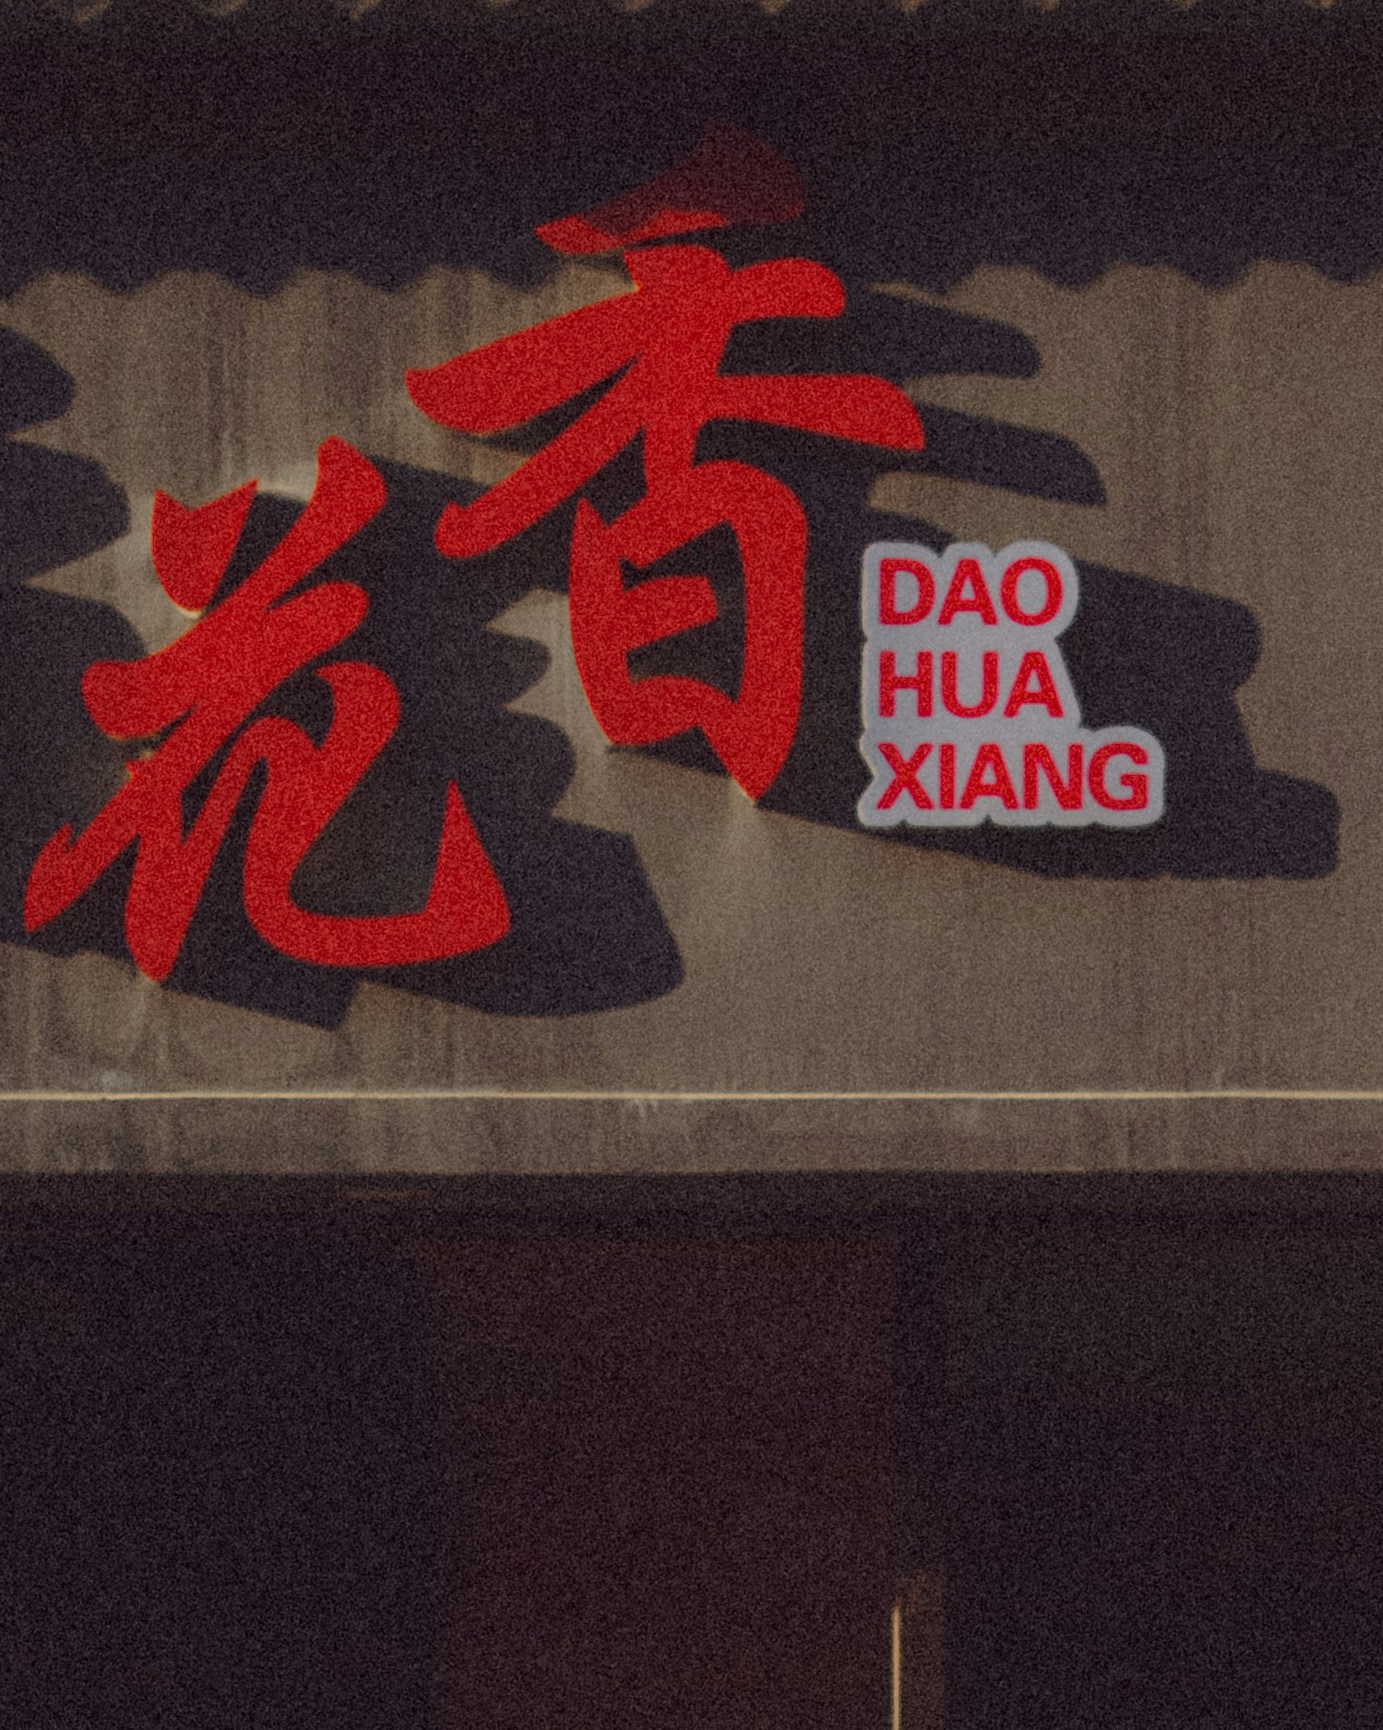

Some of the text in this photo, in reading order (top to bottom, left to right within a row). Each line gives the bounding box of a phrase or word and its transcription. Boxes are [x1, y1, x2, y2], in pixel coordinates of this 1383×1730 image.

[878, 556, 1064, 627] DAO
[877, 650, 1065, 719] HUA
[876, 741, 1150, 811] XIANG
